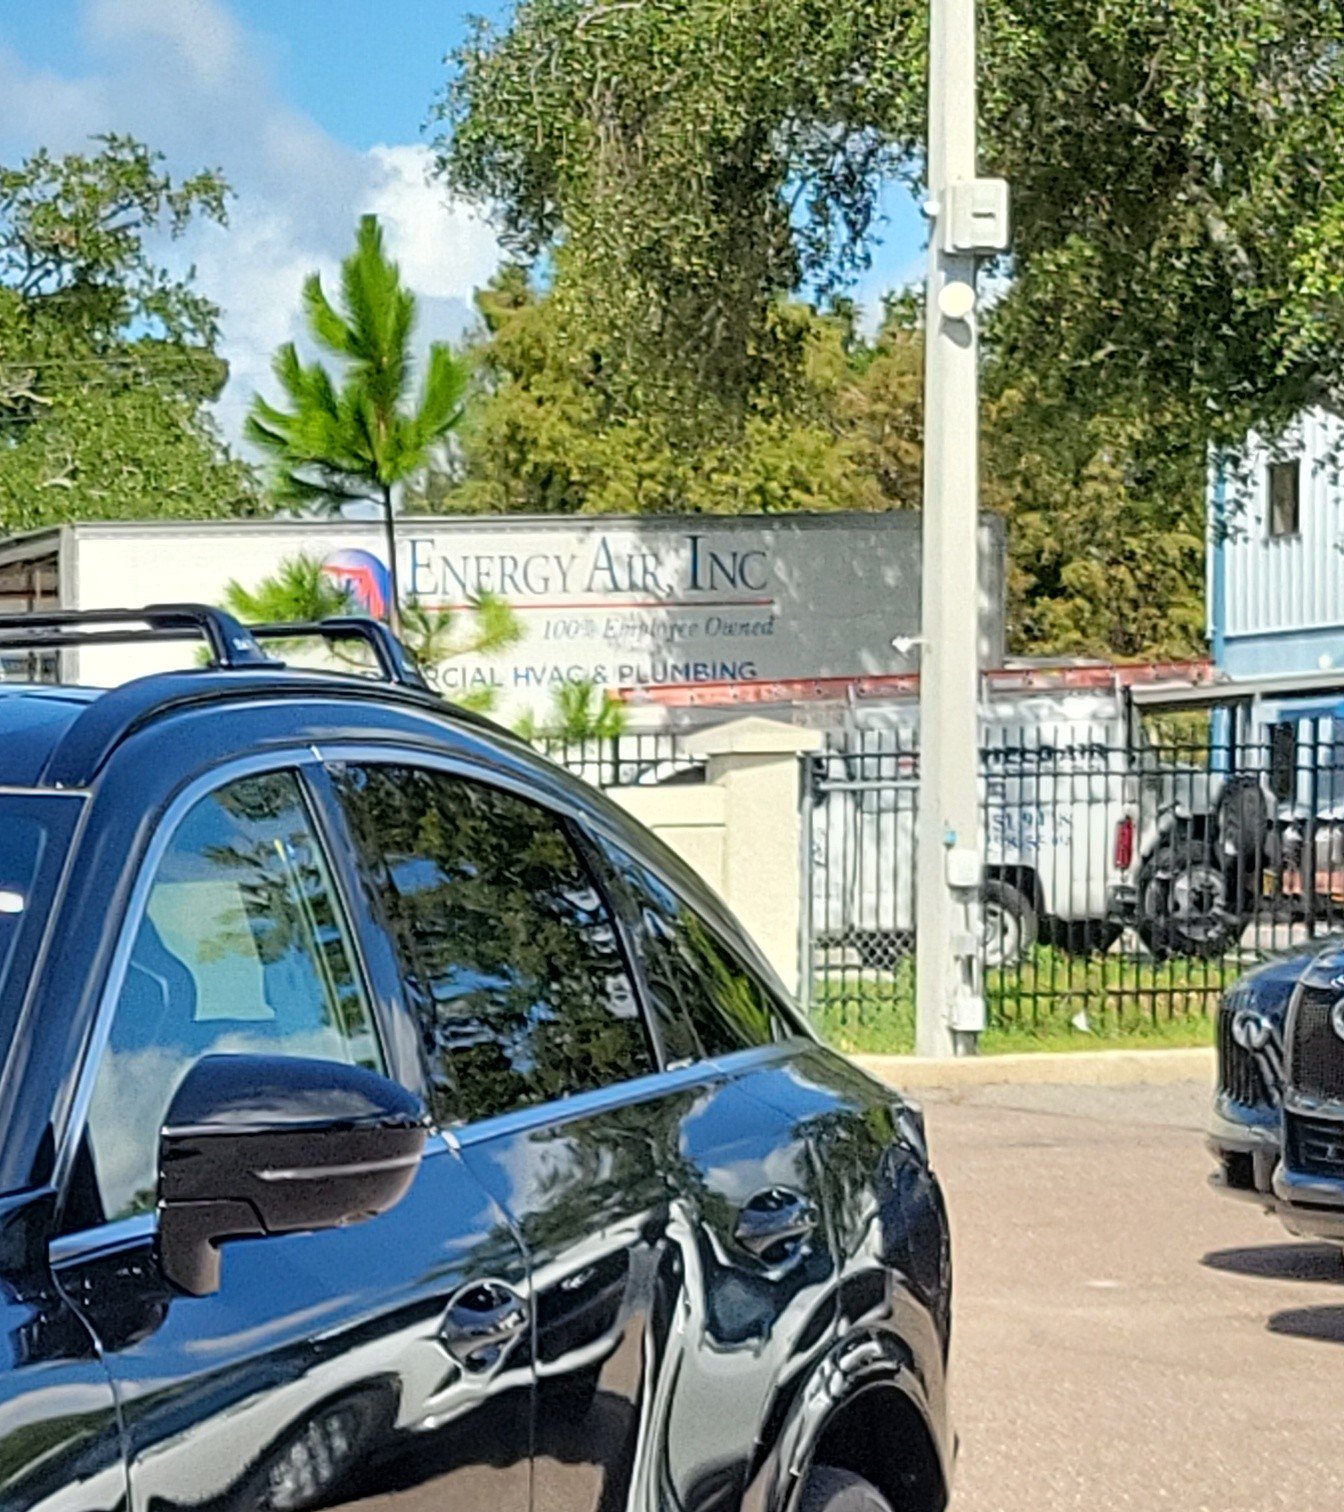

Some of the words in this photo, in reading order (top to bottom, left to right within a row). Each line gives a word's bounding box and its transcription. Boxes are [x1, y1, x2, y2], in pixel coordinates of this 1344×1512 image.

[406, 538, 577, 596] ENERGY
[586, 536, 673, 597] AIR,
[683, 534, 769, 591] INC
[704, 615, 775, 637] Owned
[513, 663, 584, 688] HVAC
[618, 661, 758, 683] PLUMBING
